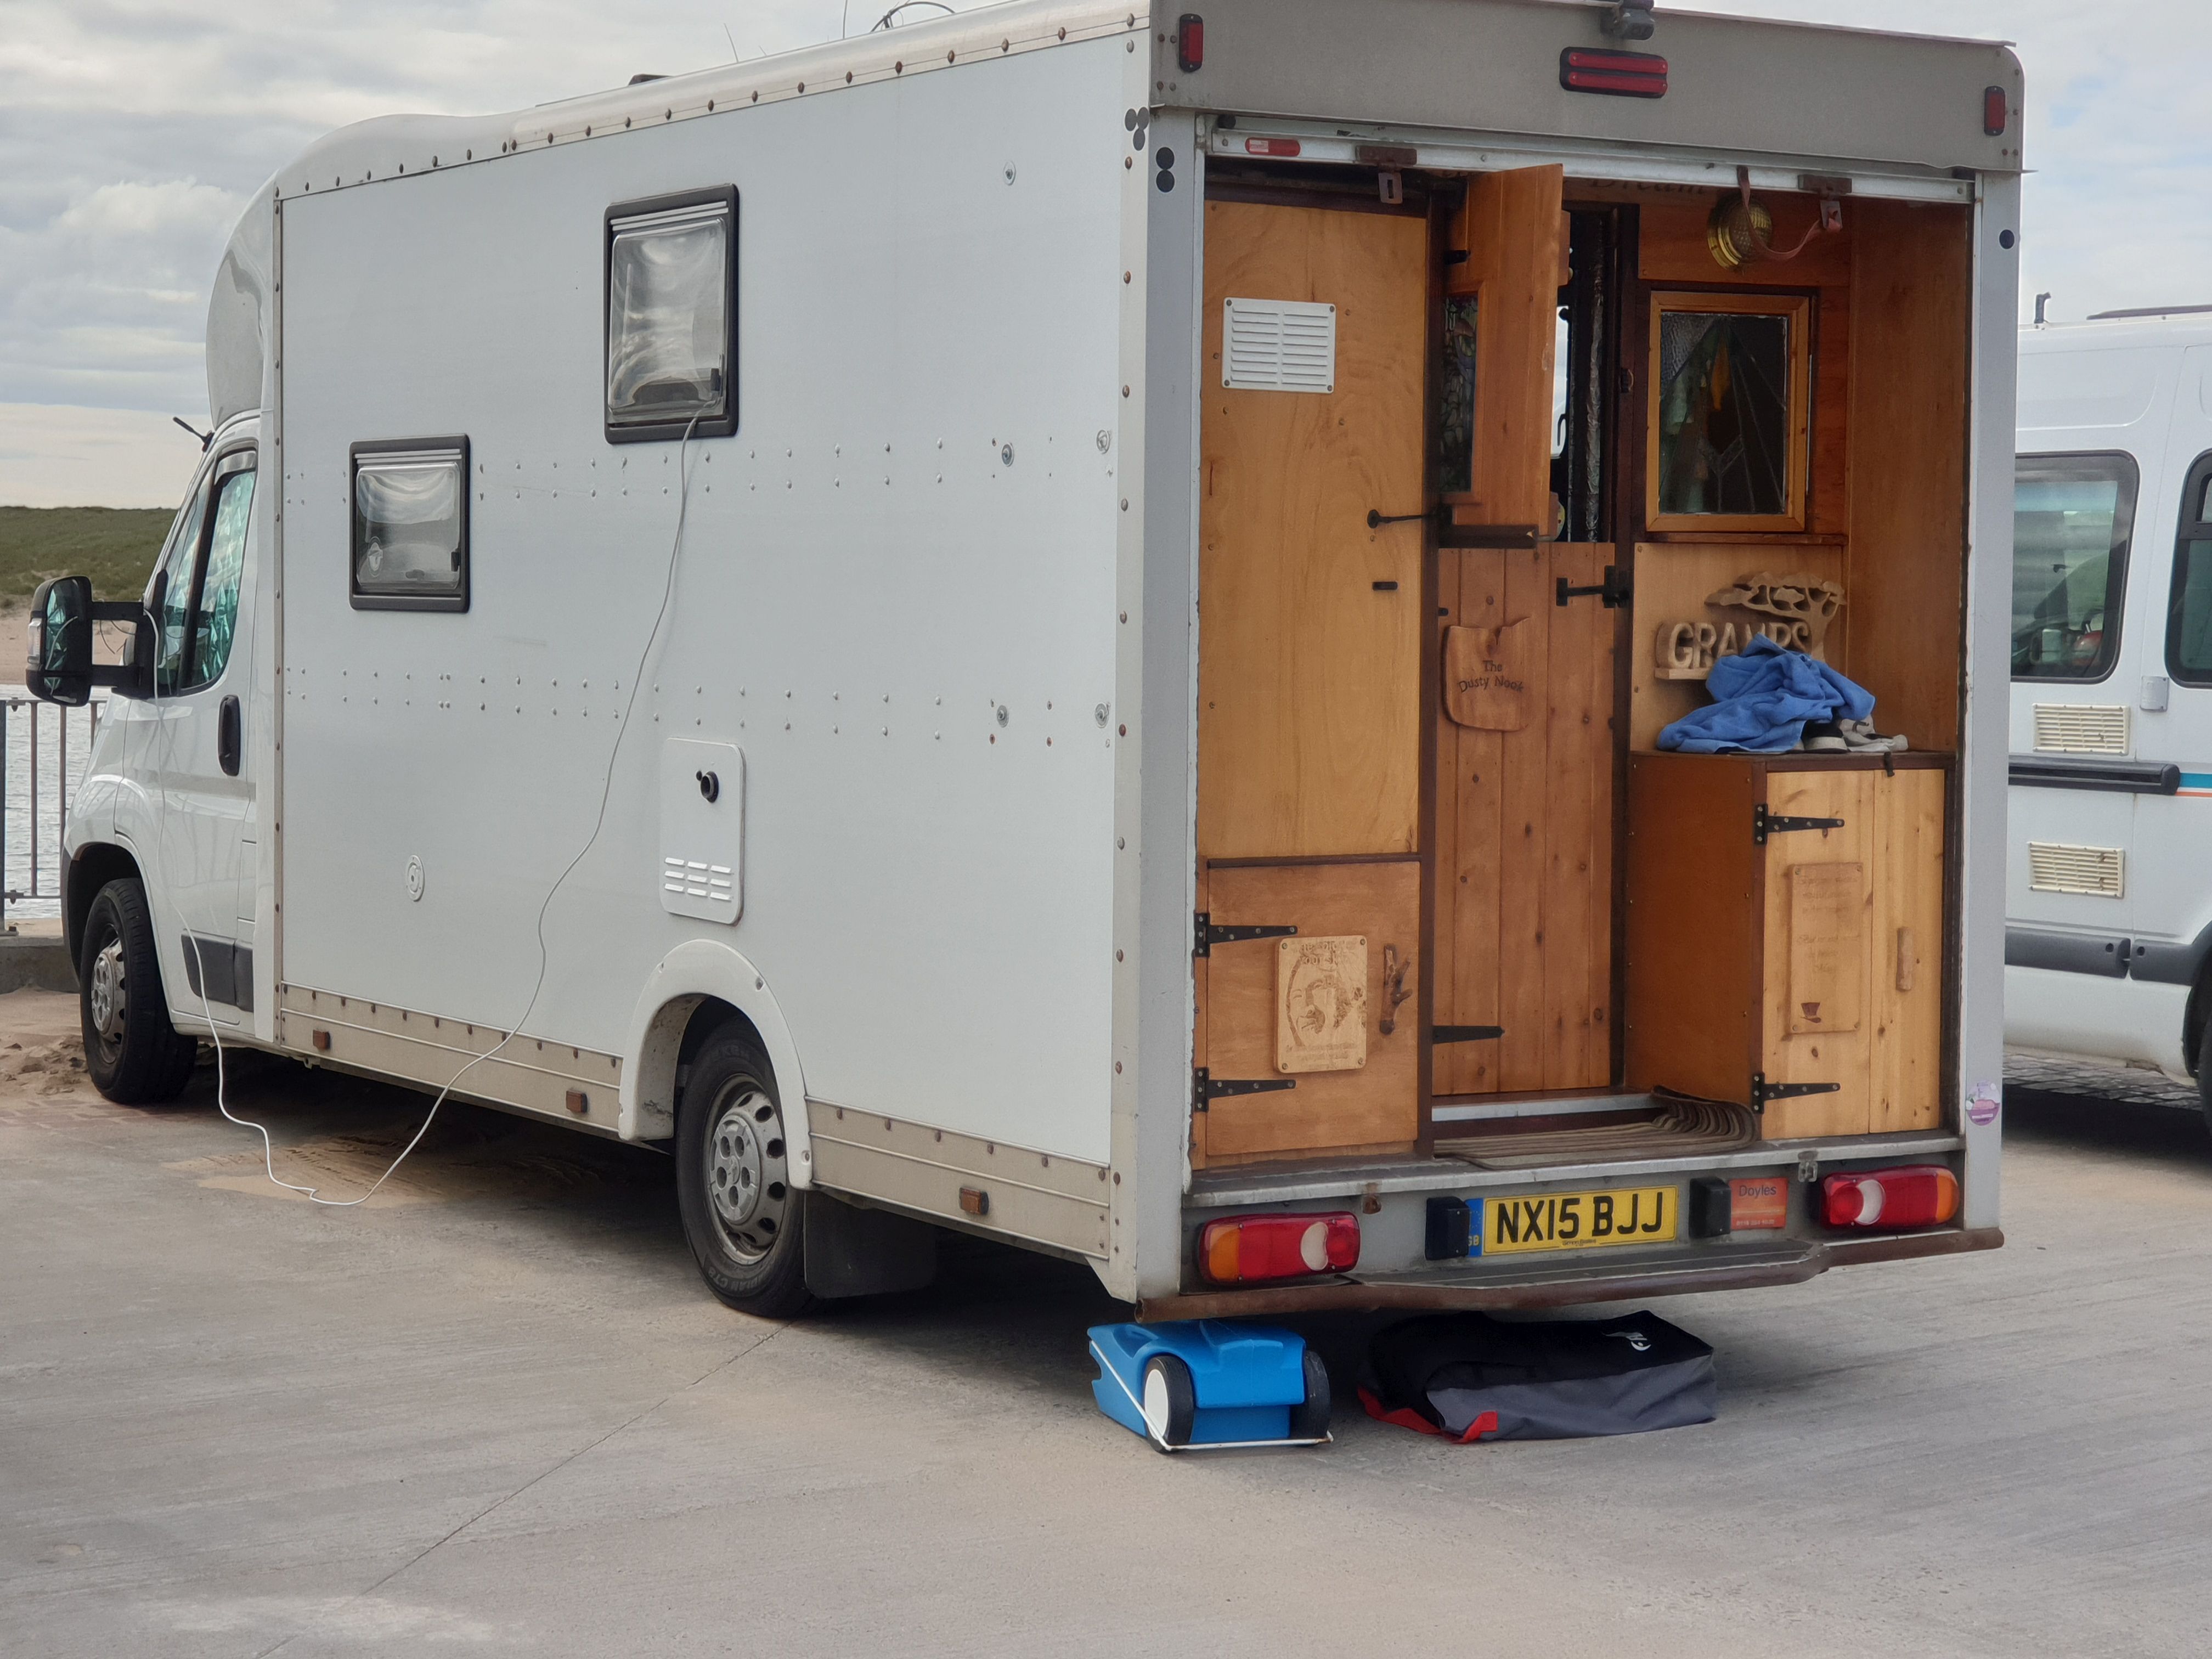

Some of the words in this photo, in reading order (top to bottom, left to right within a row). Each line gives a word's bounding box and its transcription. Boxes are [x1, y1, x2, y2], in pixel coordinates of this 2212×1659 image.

[1668, 621, 1810, 669] GRAPS
[1483, 659, 1503, 672] The
[1459, 676, 1489, 693] Dusty
[1494, 675, 1524, 692] Nook
[1739, 1185, 1777, 1199] Doyles
[1497, 1198, 1581, 1244] NX15
[1592, 1192, 1663, 1237] BJJ
